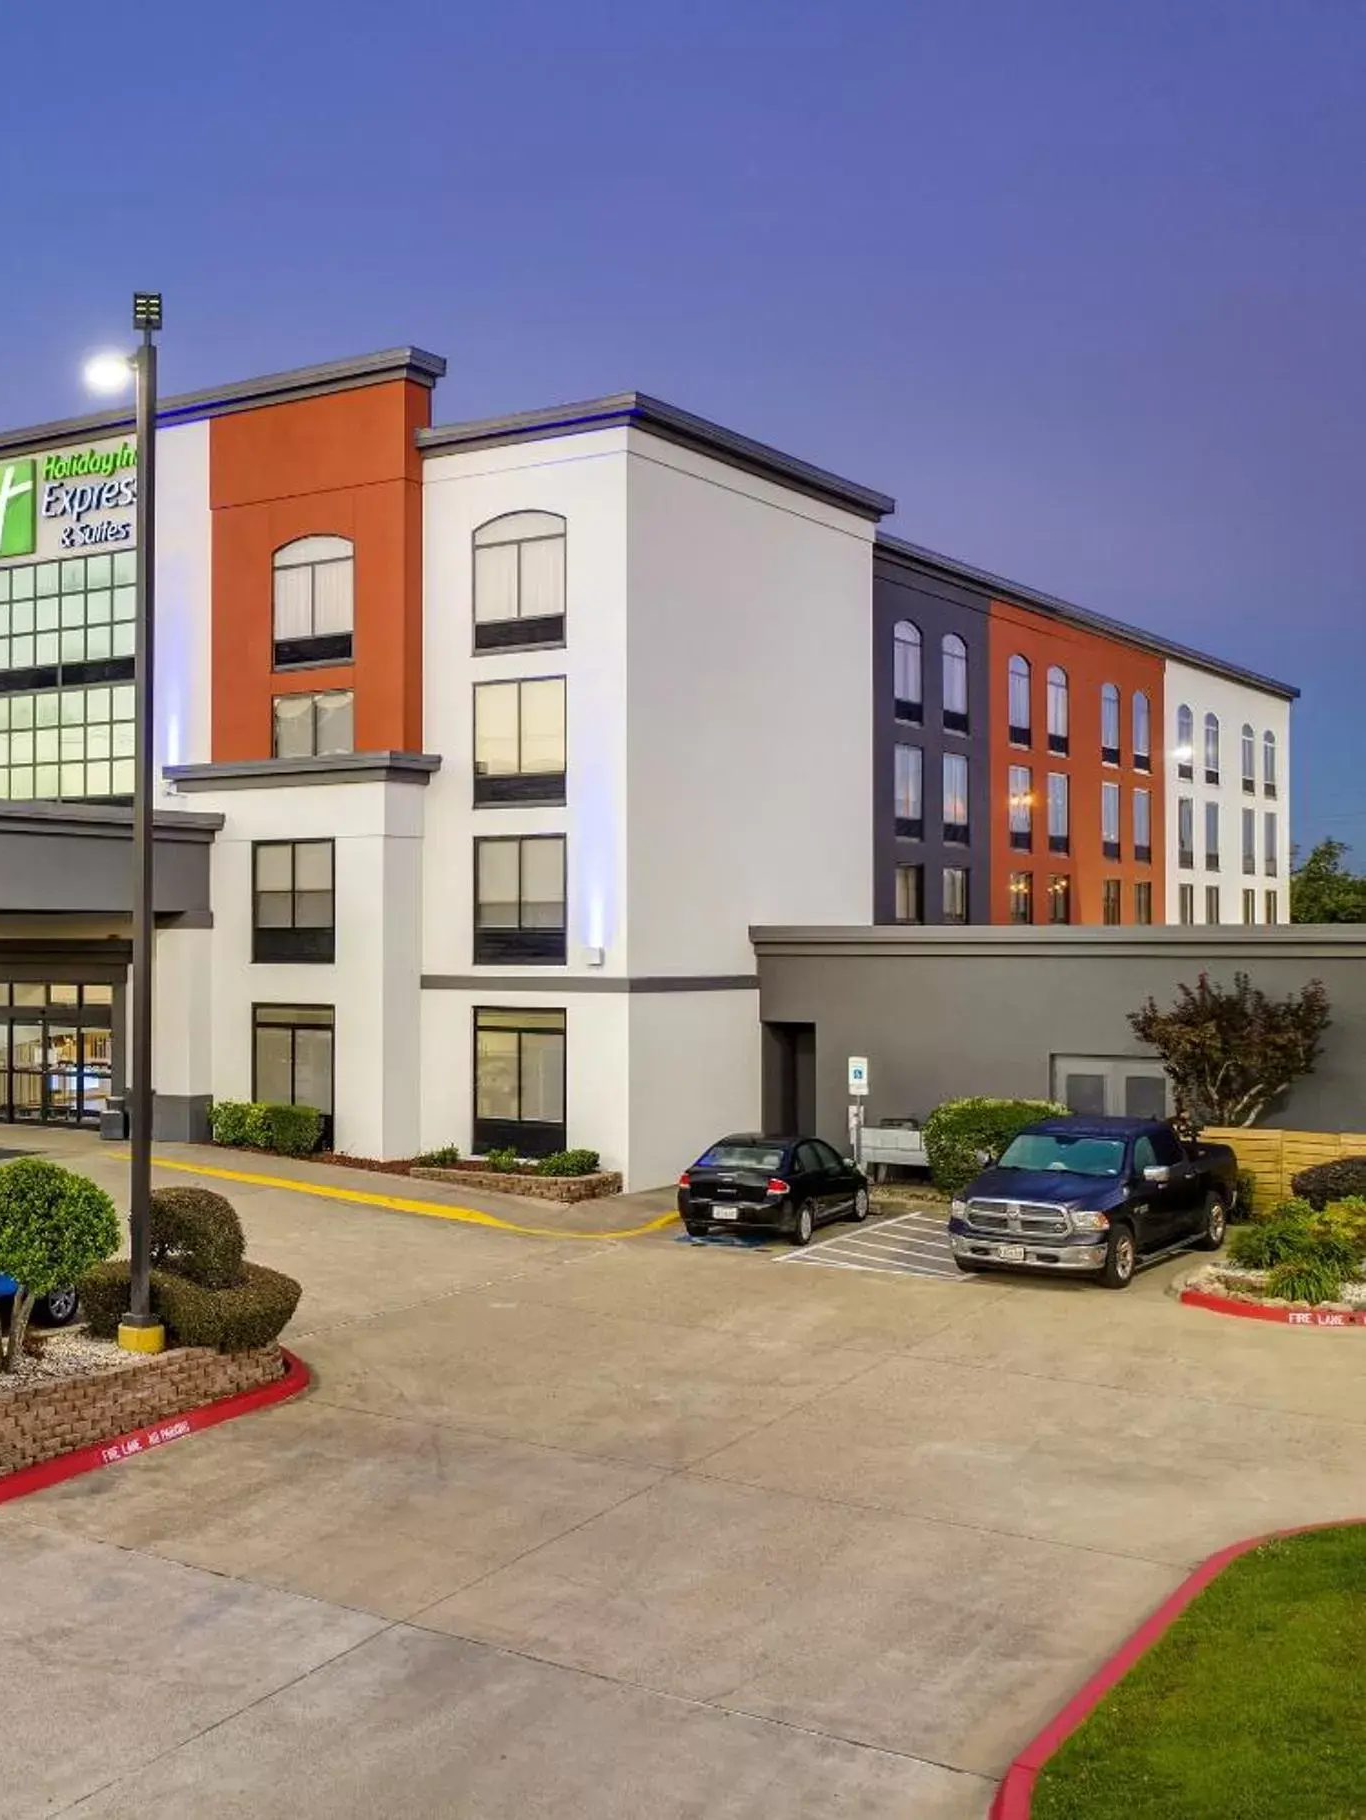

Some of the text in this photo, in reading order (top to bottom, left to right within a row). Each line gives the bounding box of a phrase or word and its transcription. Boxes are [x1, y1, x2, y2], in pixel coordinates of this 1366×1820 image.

[42, 442, 137, 481] Holiday In
[60, 520, 132, 548] & Suites
[1289, 1312, 1313, 1325] FIRE
